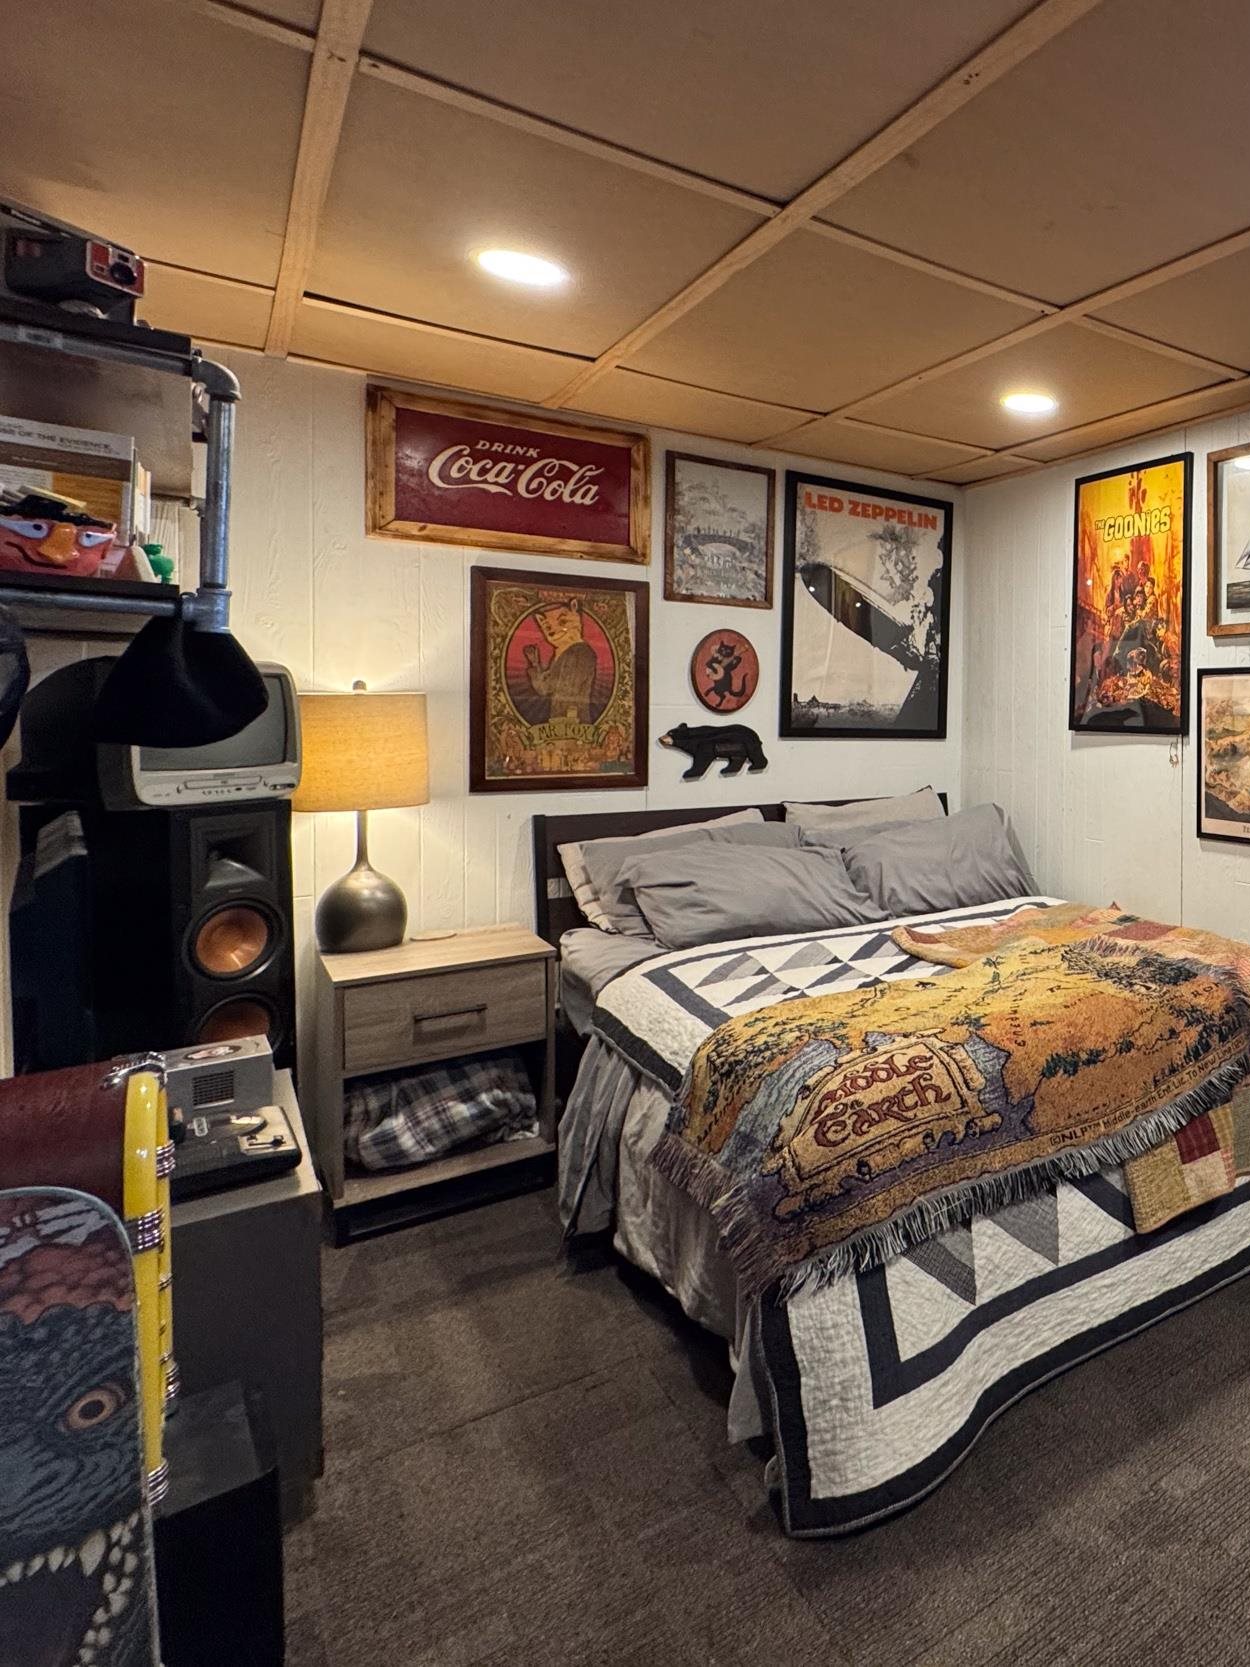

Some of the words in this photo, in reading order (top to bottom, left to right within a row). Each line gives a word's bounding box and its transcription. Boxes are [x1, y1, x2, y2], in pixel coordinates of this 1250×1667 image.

[475, 440, 541, 458] DRINK
[428, 444, 605, 506] Coca-Cola
[803, 490, 845, 513] LED
[847, 499, 938, 531] ZEPPELIN
